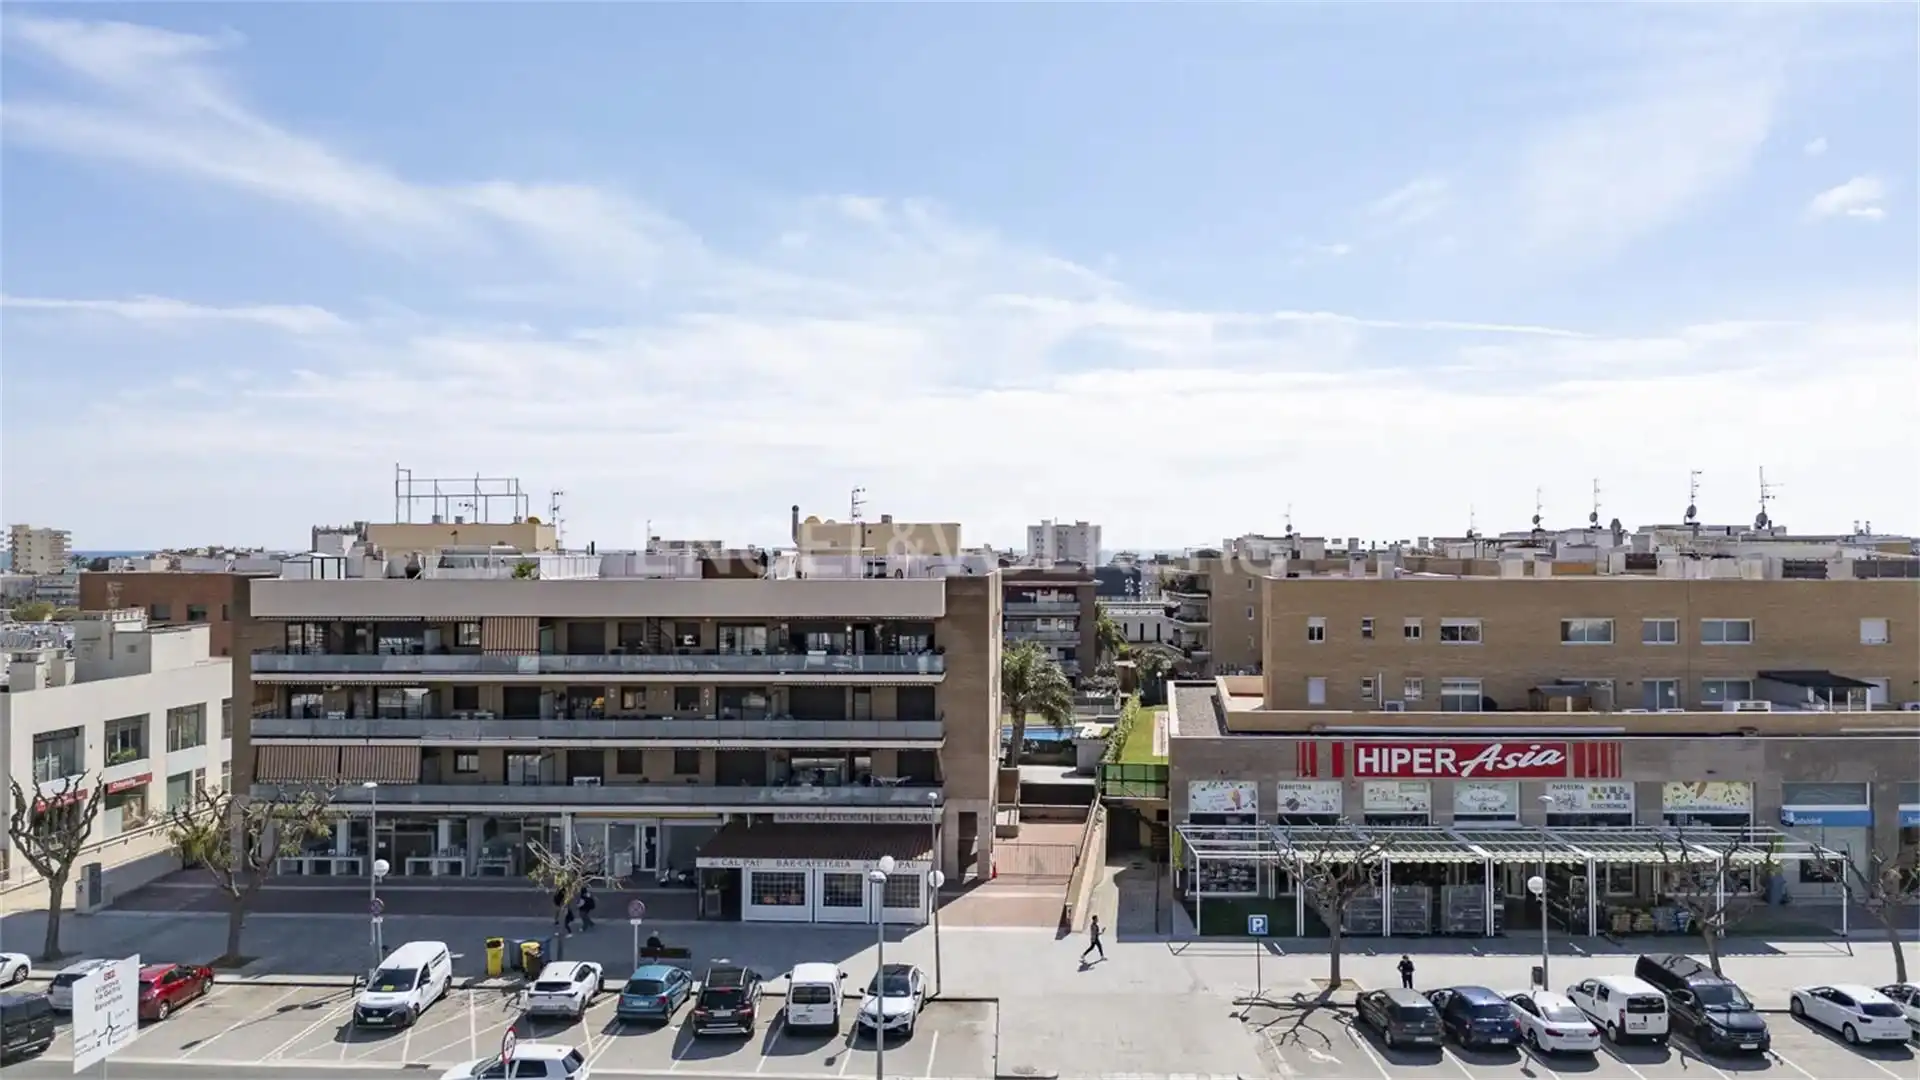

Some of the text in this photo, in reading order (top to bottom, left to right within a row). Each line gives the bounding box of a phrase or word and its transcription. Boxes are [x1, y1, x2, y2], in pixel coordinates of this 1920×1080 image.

[1358, 743, 1566, 777] HIPER Asia
[721, 859, 762, 867] CAL PAU
[898, 861, 918, 869] PAU
[1252, 918, 1264, 932] P
